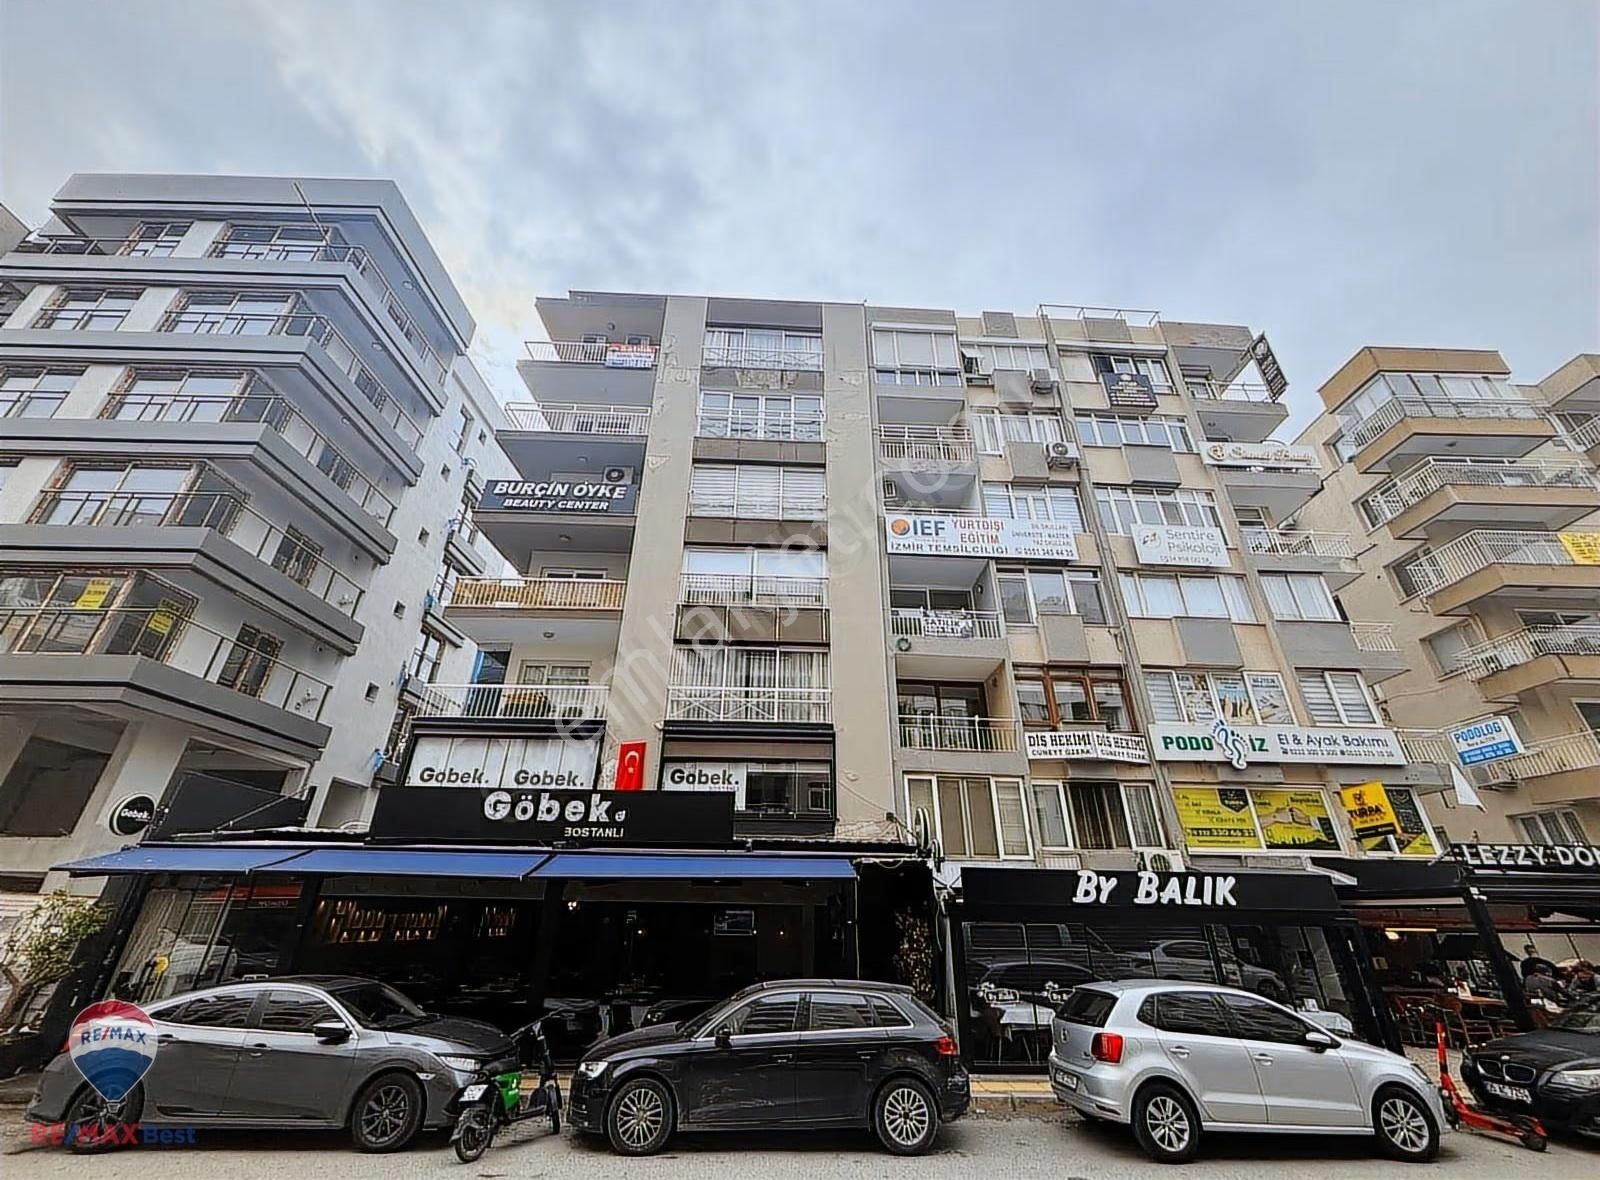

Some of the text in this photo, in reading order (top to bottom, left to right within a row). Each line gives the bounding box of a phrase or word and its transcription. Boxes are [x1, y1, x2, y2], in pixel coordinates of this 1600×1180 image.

[503, 499, 609, 510] BEAUTY CENTER
[913, 519, 945, 536] IEF
[1166, 529, 1215, 541] Sentire
[891, 542, 923, 552] İZMİR
[1454, 722, 1502, 743] PODOLOG
[1292, 734, 1302, 745] &
[1306, 734, 1340, 748] Ayak
[1462, 844, 1547, 865] LEZZY
